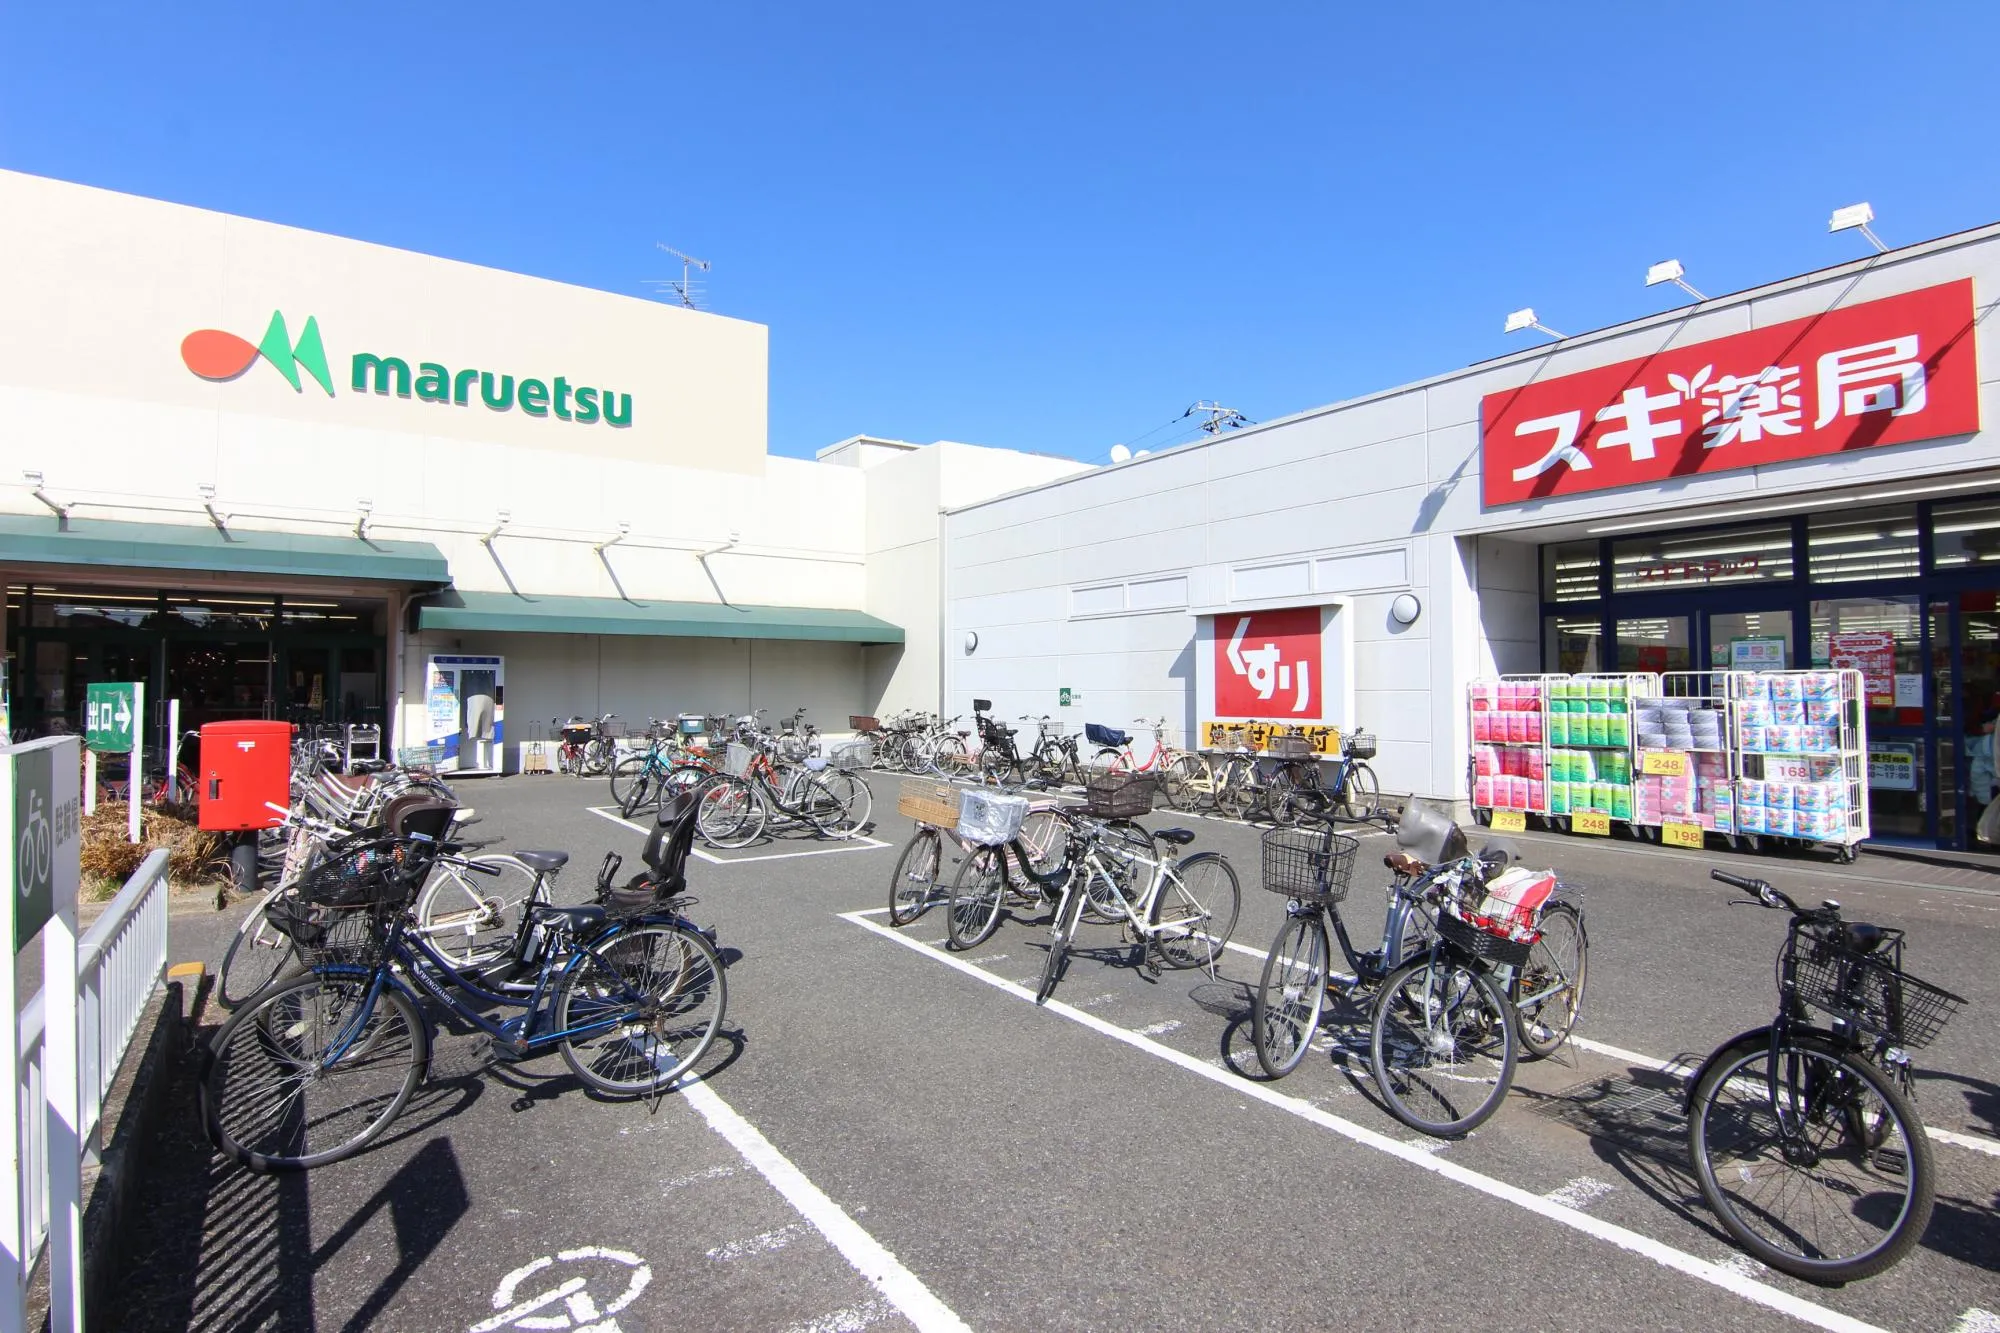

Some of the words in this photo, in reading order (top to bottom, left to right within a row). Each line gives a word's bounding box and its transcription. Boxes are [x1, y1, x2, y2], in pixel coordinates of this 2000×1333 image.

[351, 352, 632, 429] maruetsu
[1513, 334, 1928, 482] スギ薬局
[1226, 617, 1310, 712] くすり
[87, 700, 112, 731] 出口
[1653, 759, 1679, 769] 248
[1779, 766, 1806, 777] 168
[1582, 818, 1605, 830] 248
[1673, 830, 1699, 842] 198
